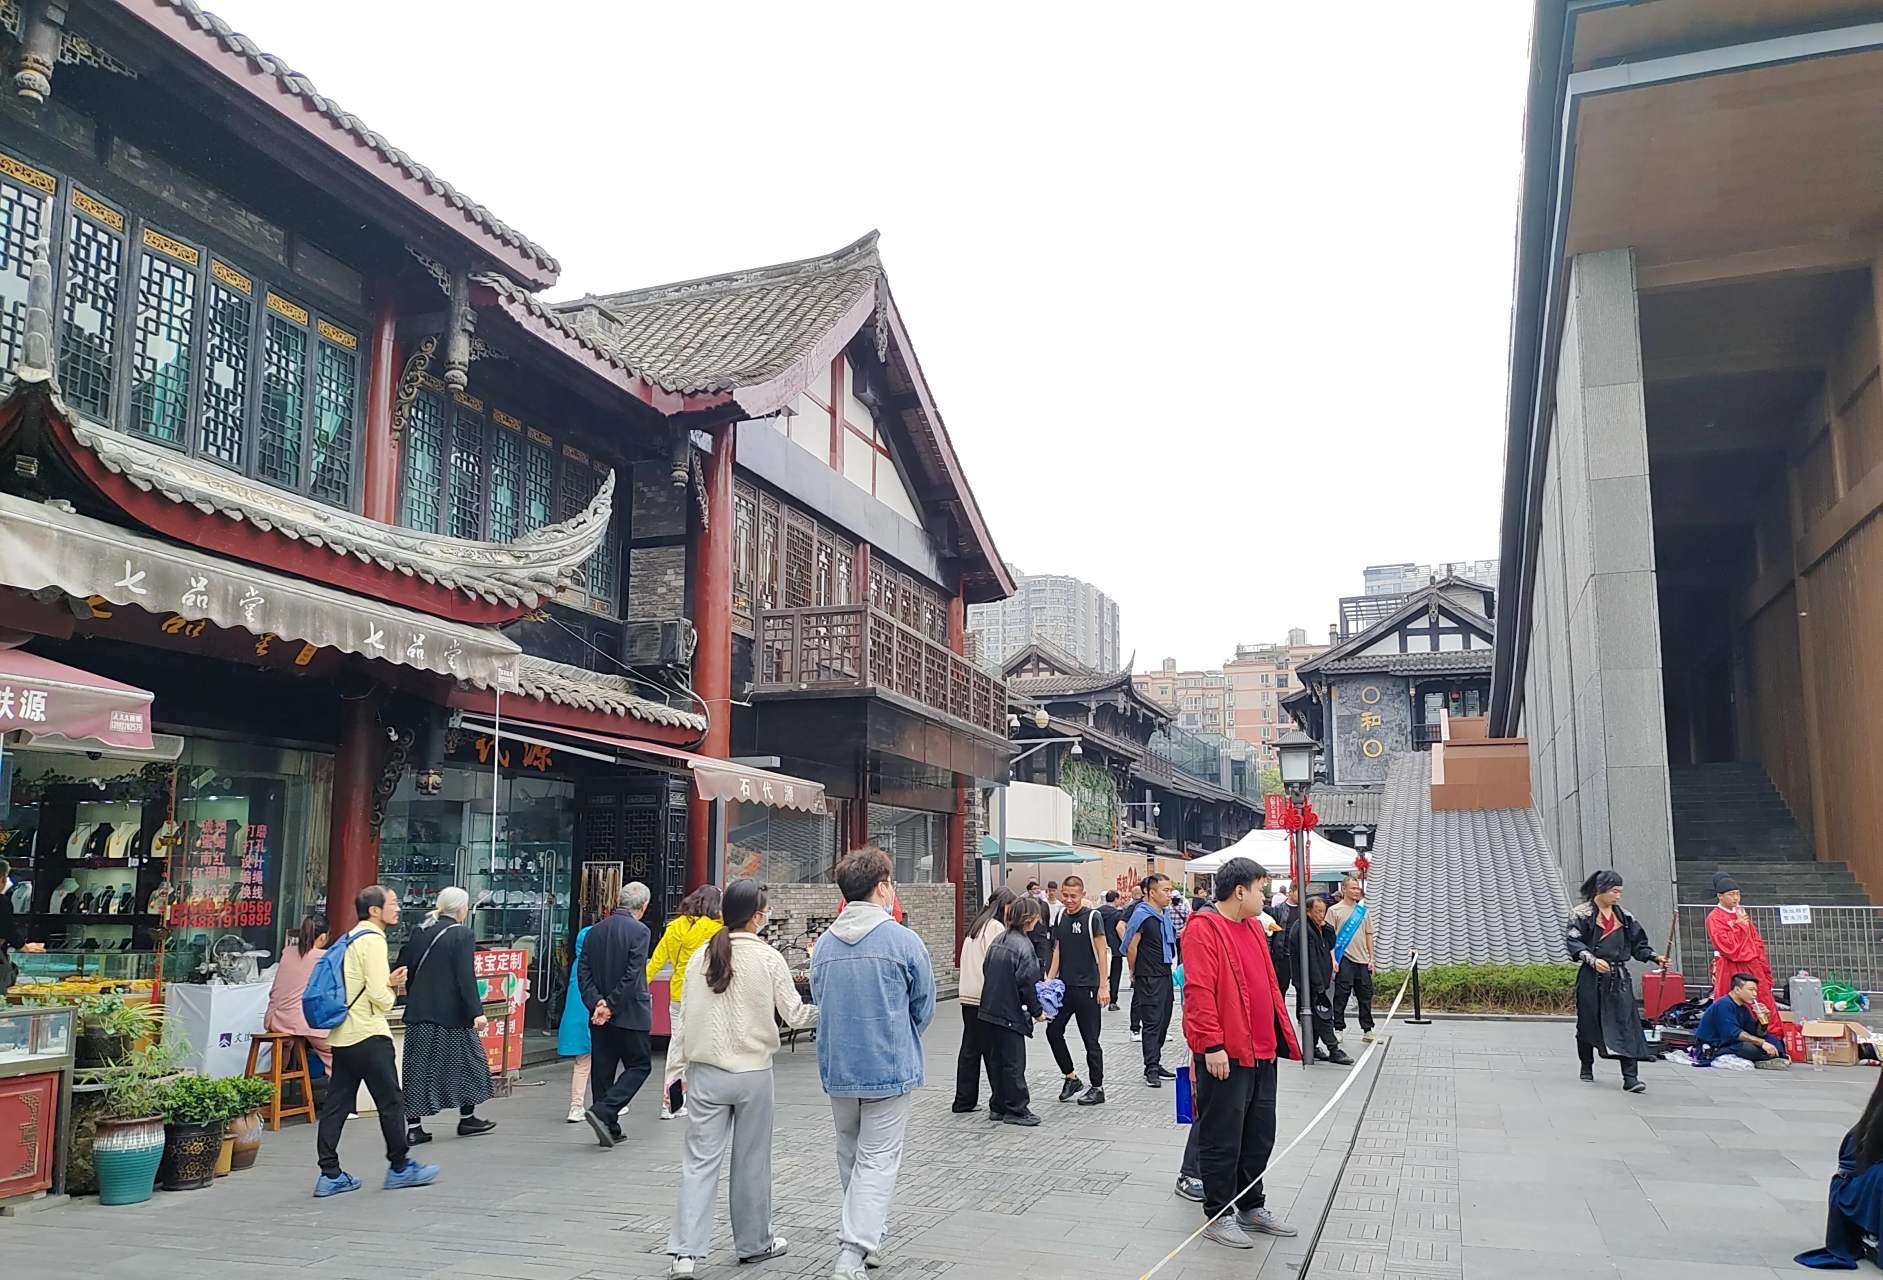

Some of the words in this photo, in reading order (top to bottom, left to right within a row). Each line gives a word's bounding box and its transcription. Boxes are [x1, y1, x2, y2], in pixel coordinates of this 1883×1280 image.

[114, 559, 264, 624] 七品堂
[363, 621, 462, 670] 七品堂
[738, 778, 795, 803] 石代源
[243, 824, 268, 839] 打磨
[242, 839, 266, 853] 打孔
[200, 851, 226, 866] 南红
[240, 854, 265, 869] 设计
[192, 866, 231, 881] 红珊瑚
[240, 870, 264, 885] 编绳
[239, 885, 264, 900] 换线
[1072, 921, 1082, 934] NY
[474, 952, 522, 972] 珠宝定制
